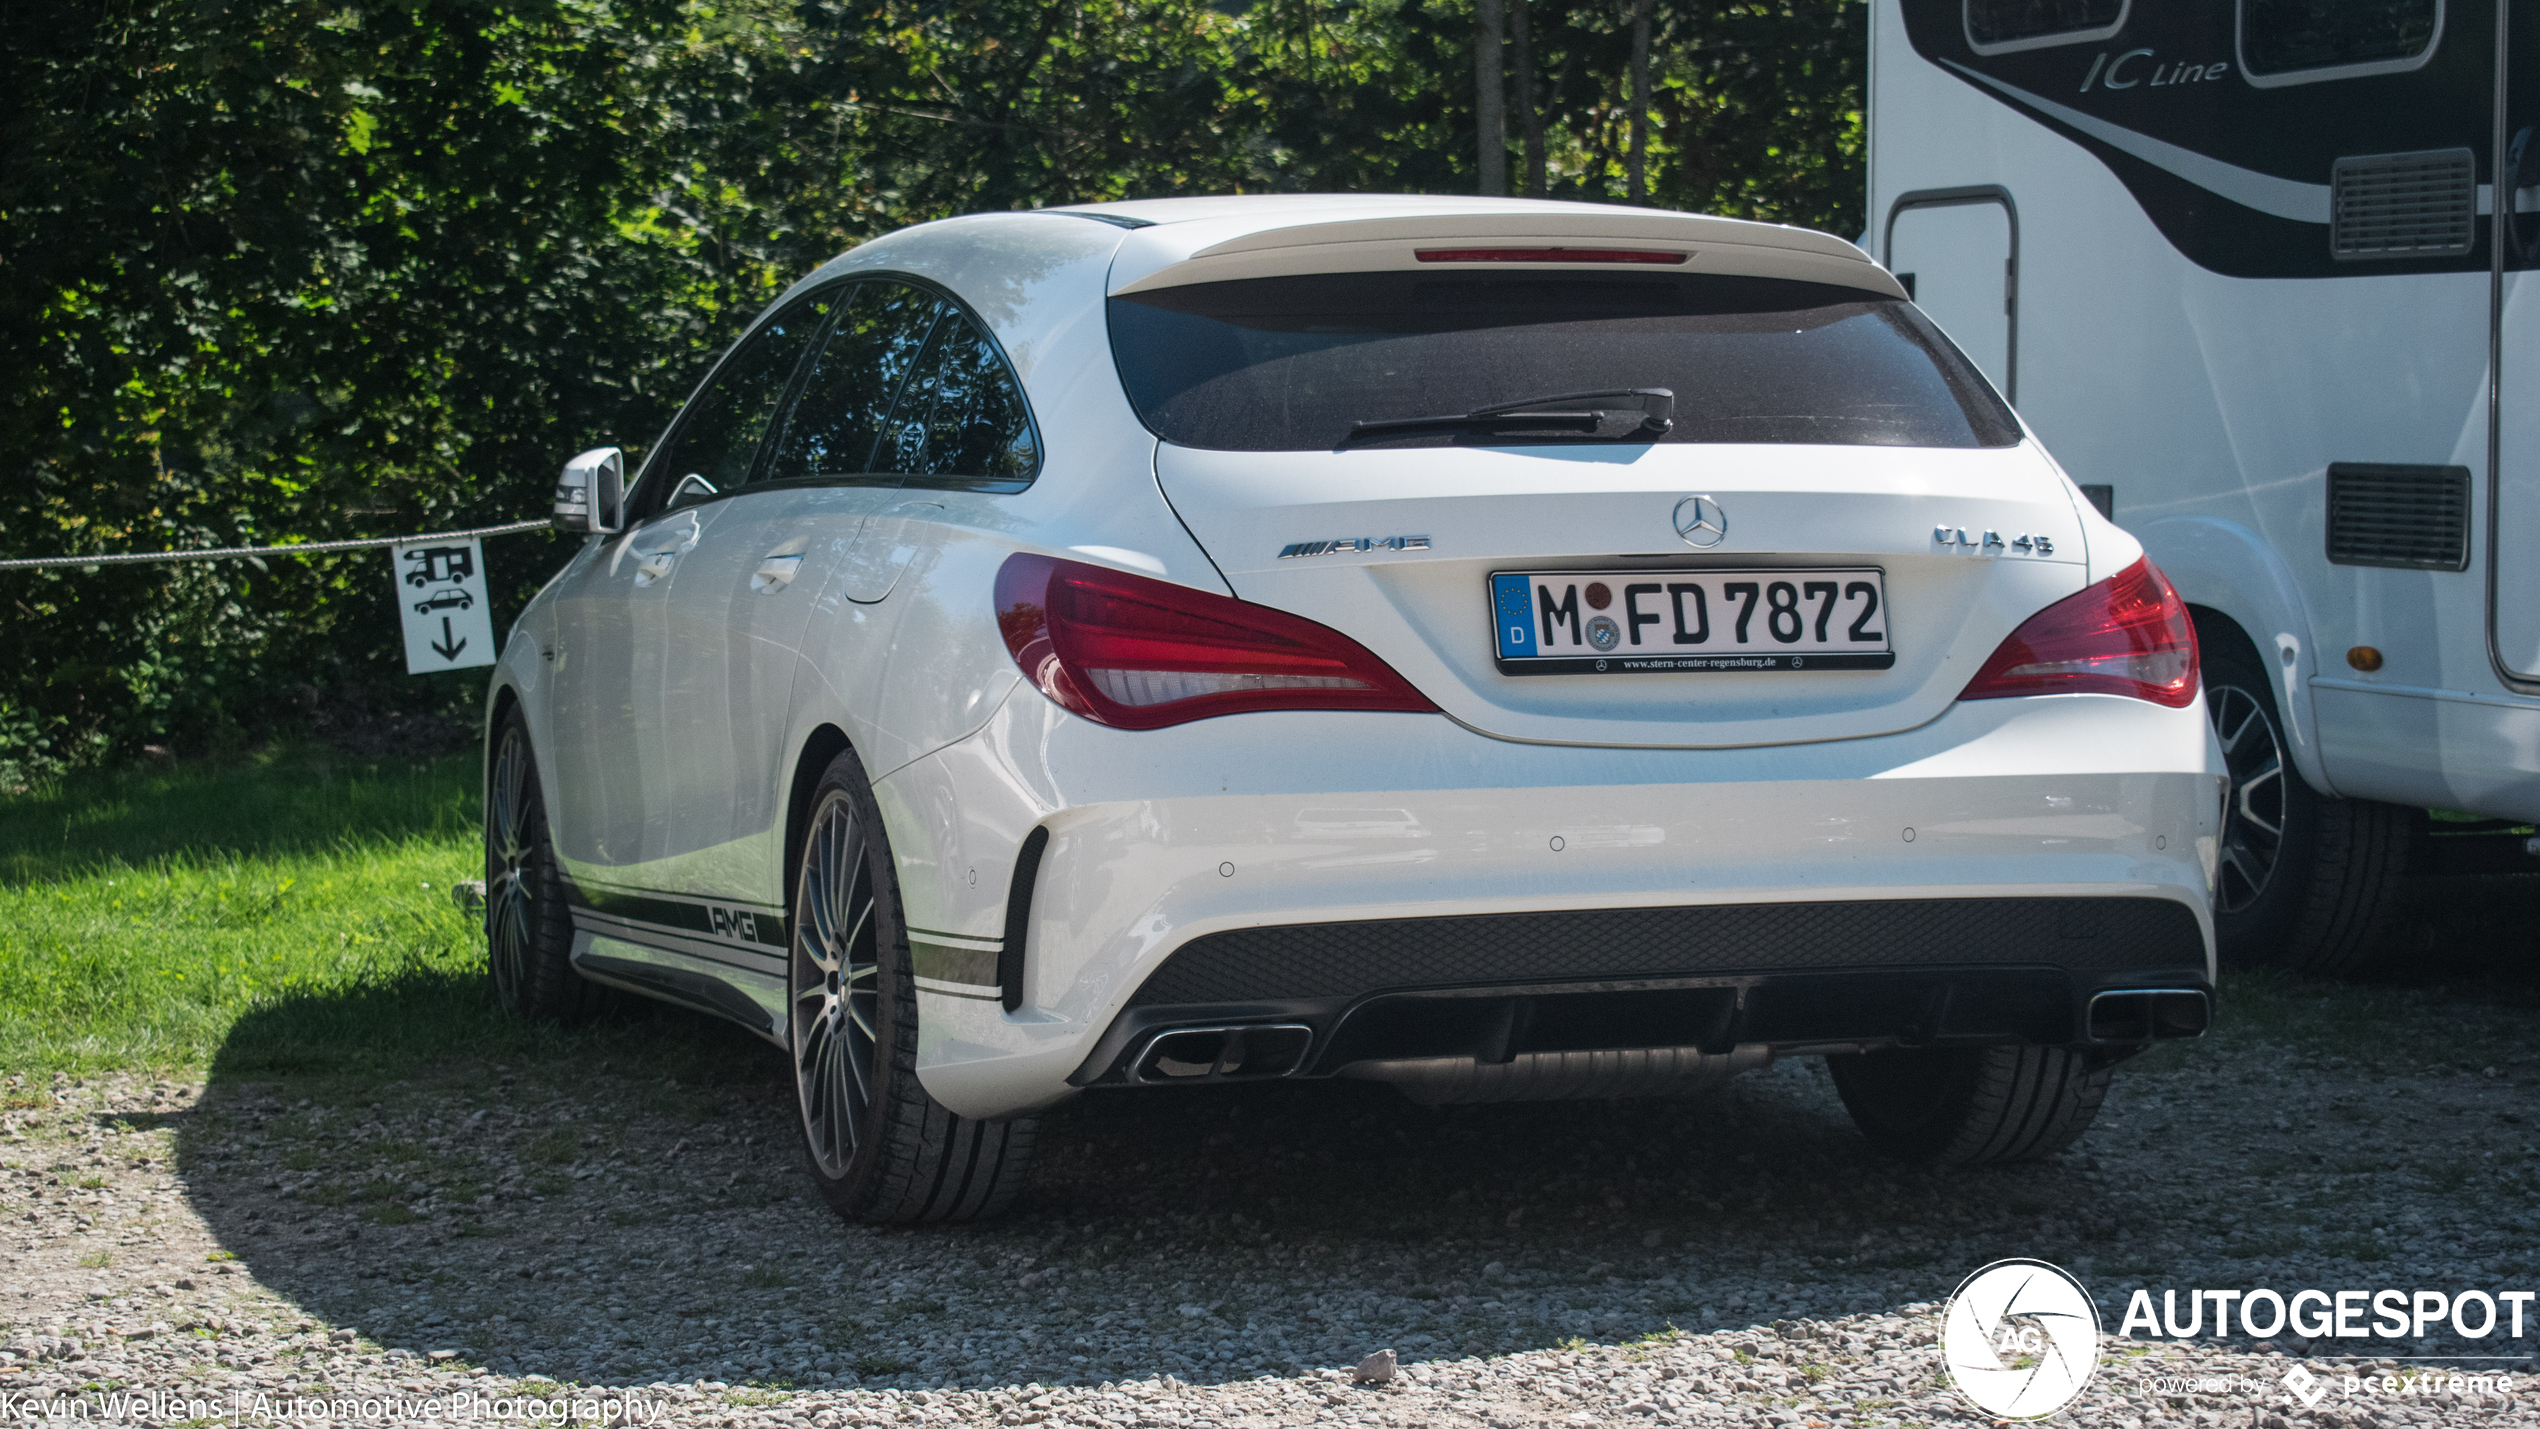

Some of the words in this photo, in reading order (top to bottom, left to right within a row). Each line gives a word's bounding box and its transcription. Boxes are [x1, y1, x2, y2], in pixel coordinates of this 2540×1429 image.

[2079, 48, 2154, 92] IC
[2150, 61, 2228, 86] Line
[1334, 535, 1431, 553] AMG
[1934, 524, 2005, 548] CLA
[2012, 532, 2054, 552] 45
[1537, 584, 1582, 646] M
[1624, 583, 1709, 645] FD
[1724, 581, 1883, 644] 7872
[1510, 626, 1525, 644] D
[1623, 657, 1776, 669] www.stern-center-regensburg.de
[712, 907, 757, 942] AMG
